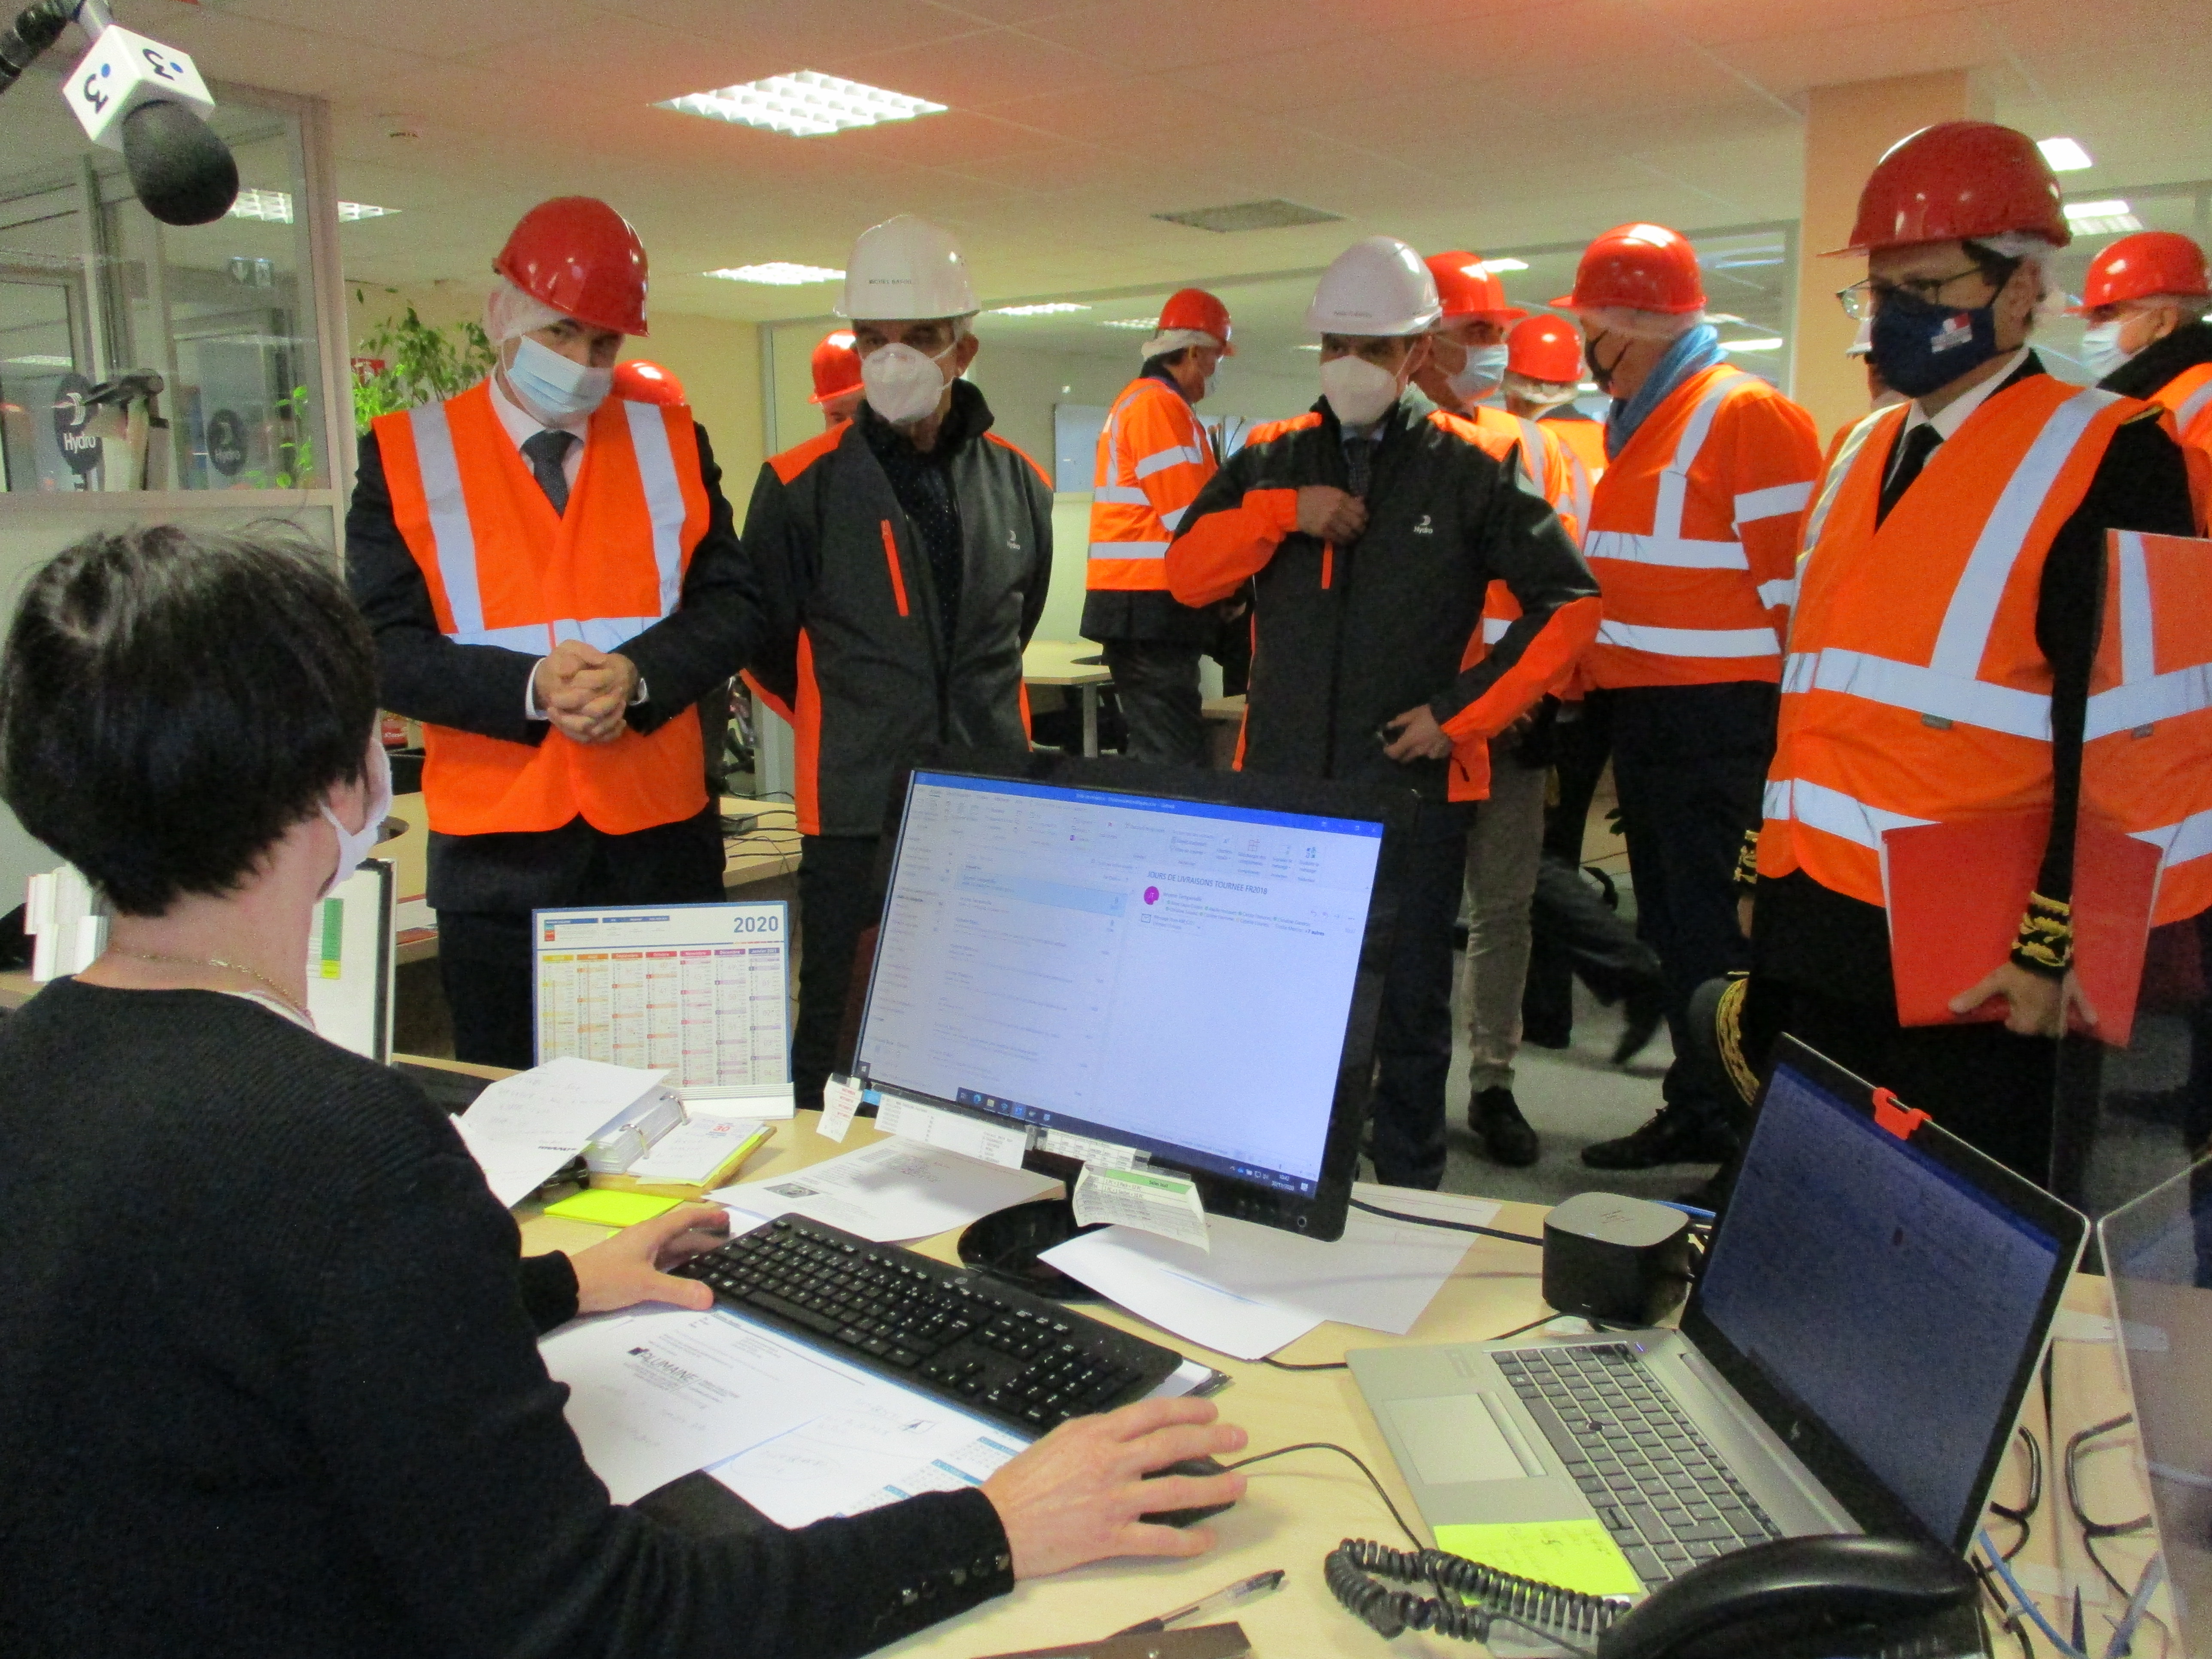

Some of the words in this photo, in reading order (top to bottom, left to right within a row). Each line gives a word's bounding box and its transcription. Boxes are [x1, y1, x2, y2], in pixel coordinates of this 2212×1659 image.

[63, 431, 96, 454] Hydro
[1147, 871, 1166, 880] JOURS
[1177, 876, 1213, 887] LIVRAISONS
[1215, 881, 1244, 891] TOURNEE
[1246, 885, 1267, 895] FR2018
[734, 916, 778, 933] 2020
